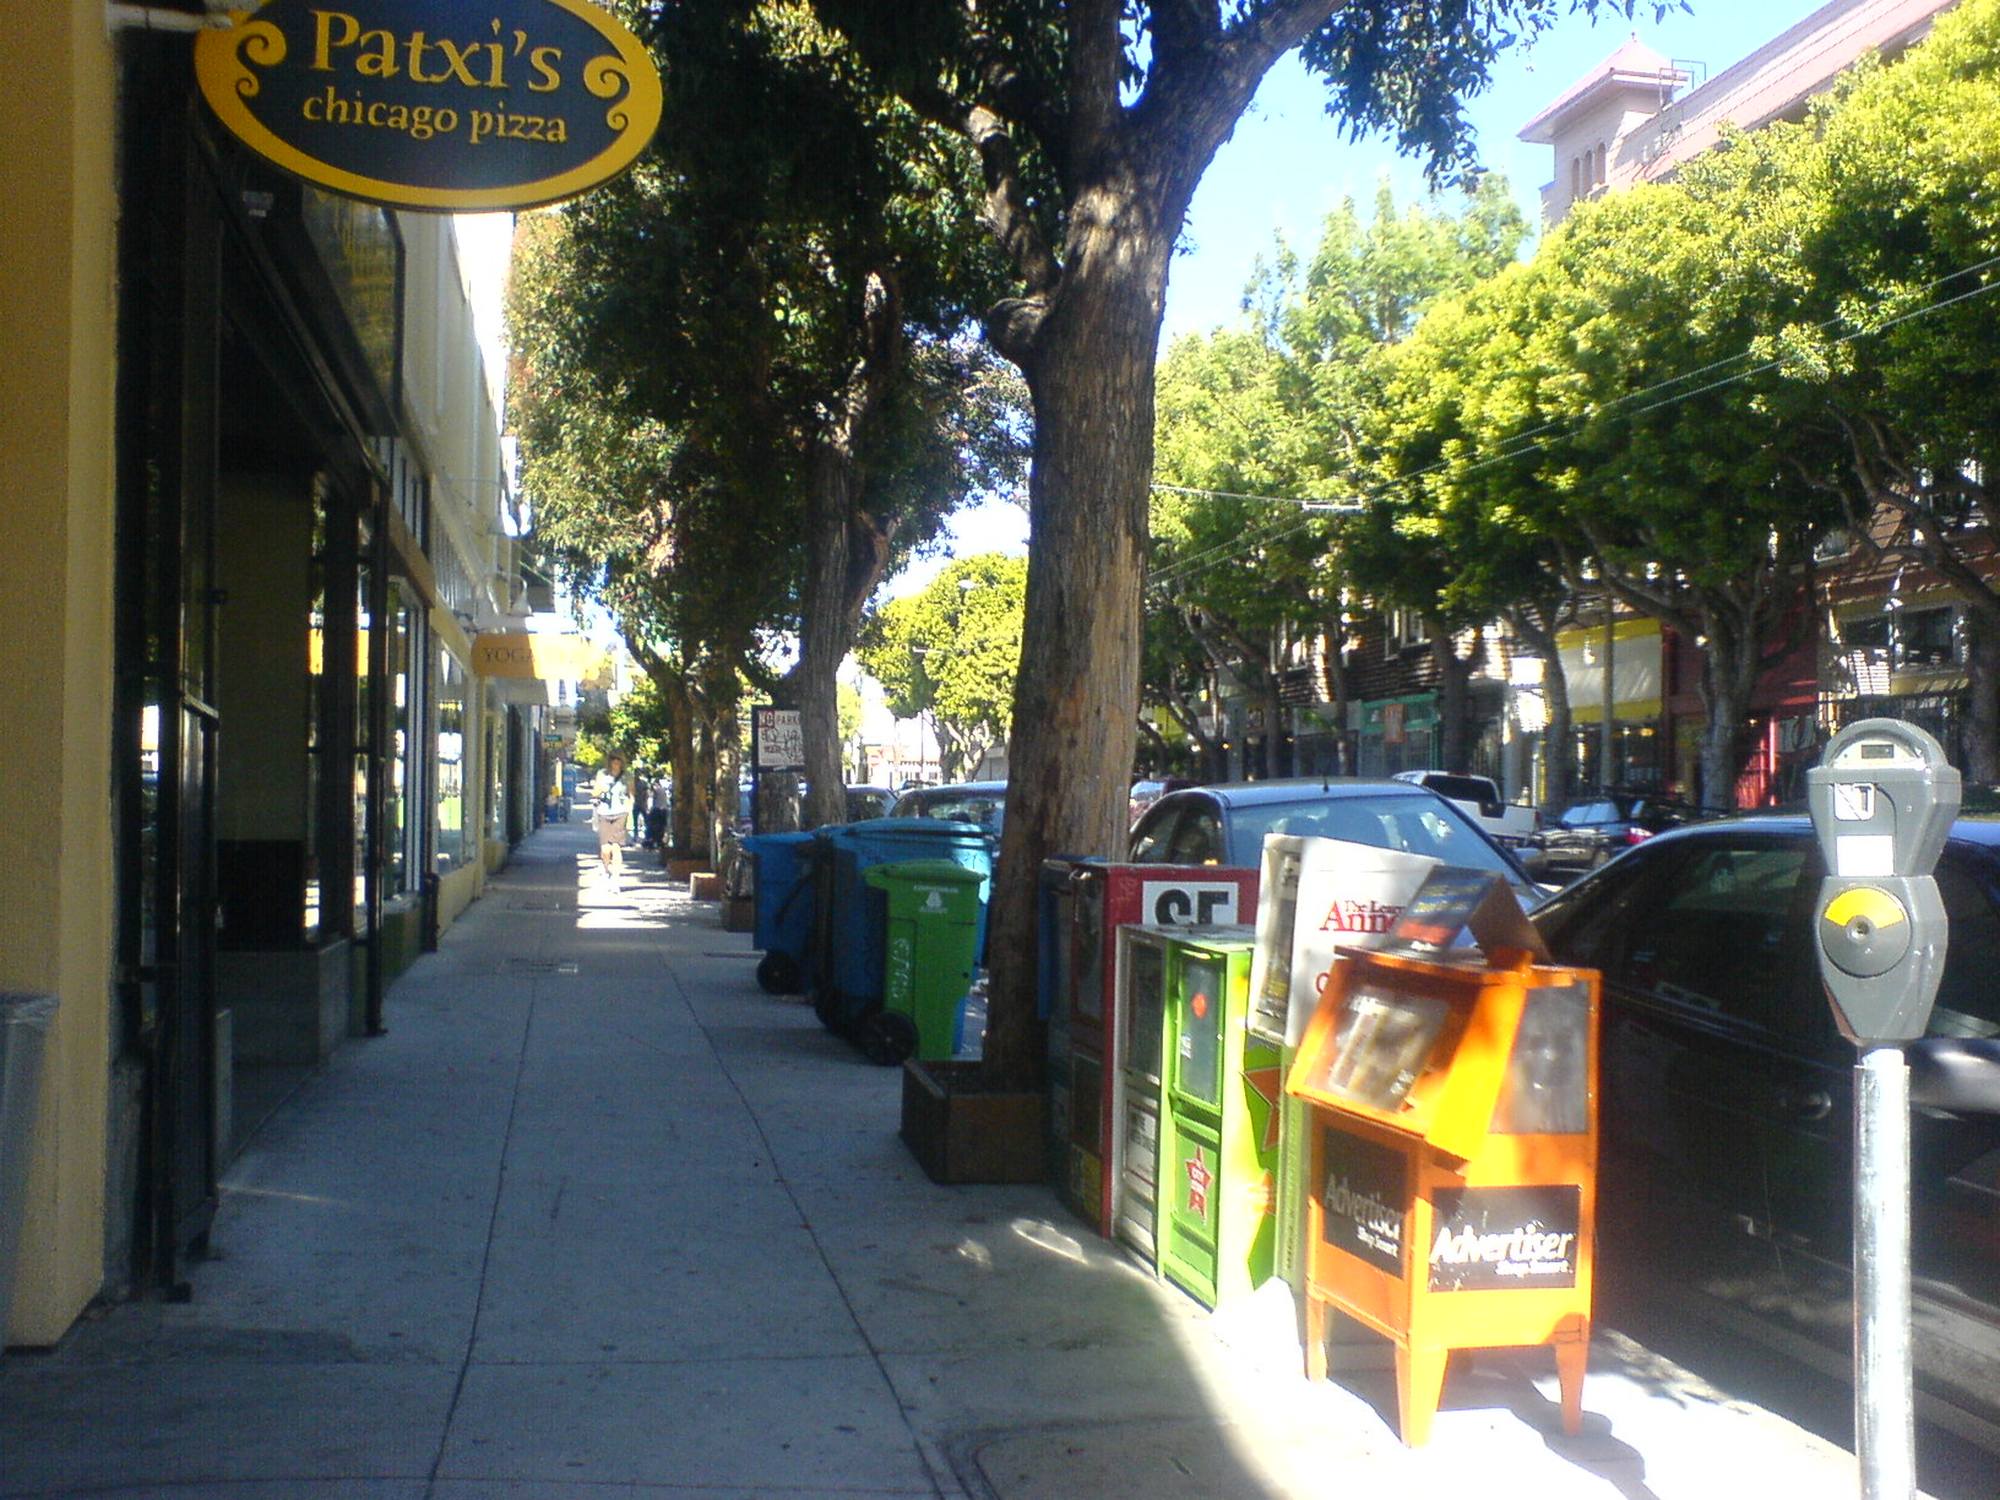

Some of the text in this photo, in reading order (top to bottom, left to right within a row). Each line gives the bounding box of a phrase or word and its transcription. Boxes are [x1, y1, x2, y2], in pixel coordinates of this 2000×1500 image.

[310, 9, 562, 92] Patxi's
[303, 86, 567, 144] chicago pizza
[1326, 1173, 1400, 1241] Advertiser
[1429, 1223, 1576, 1264] Advertiser
